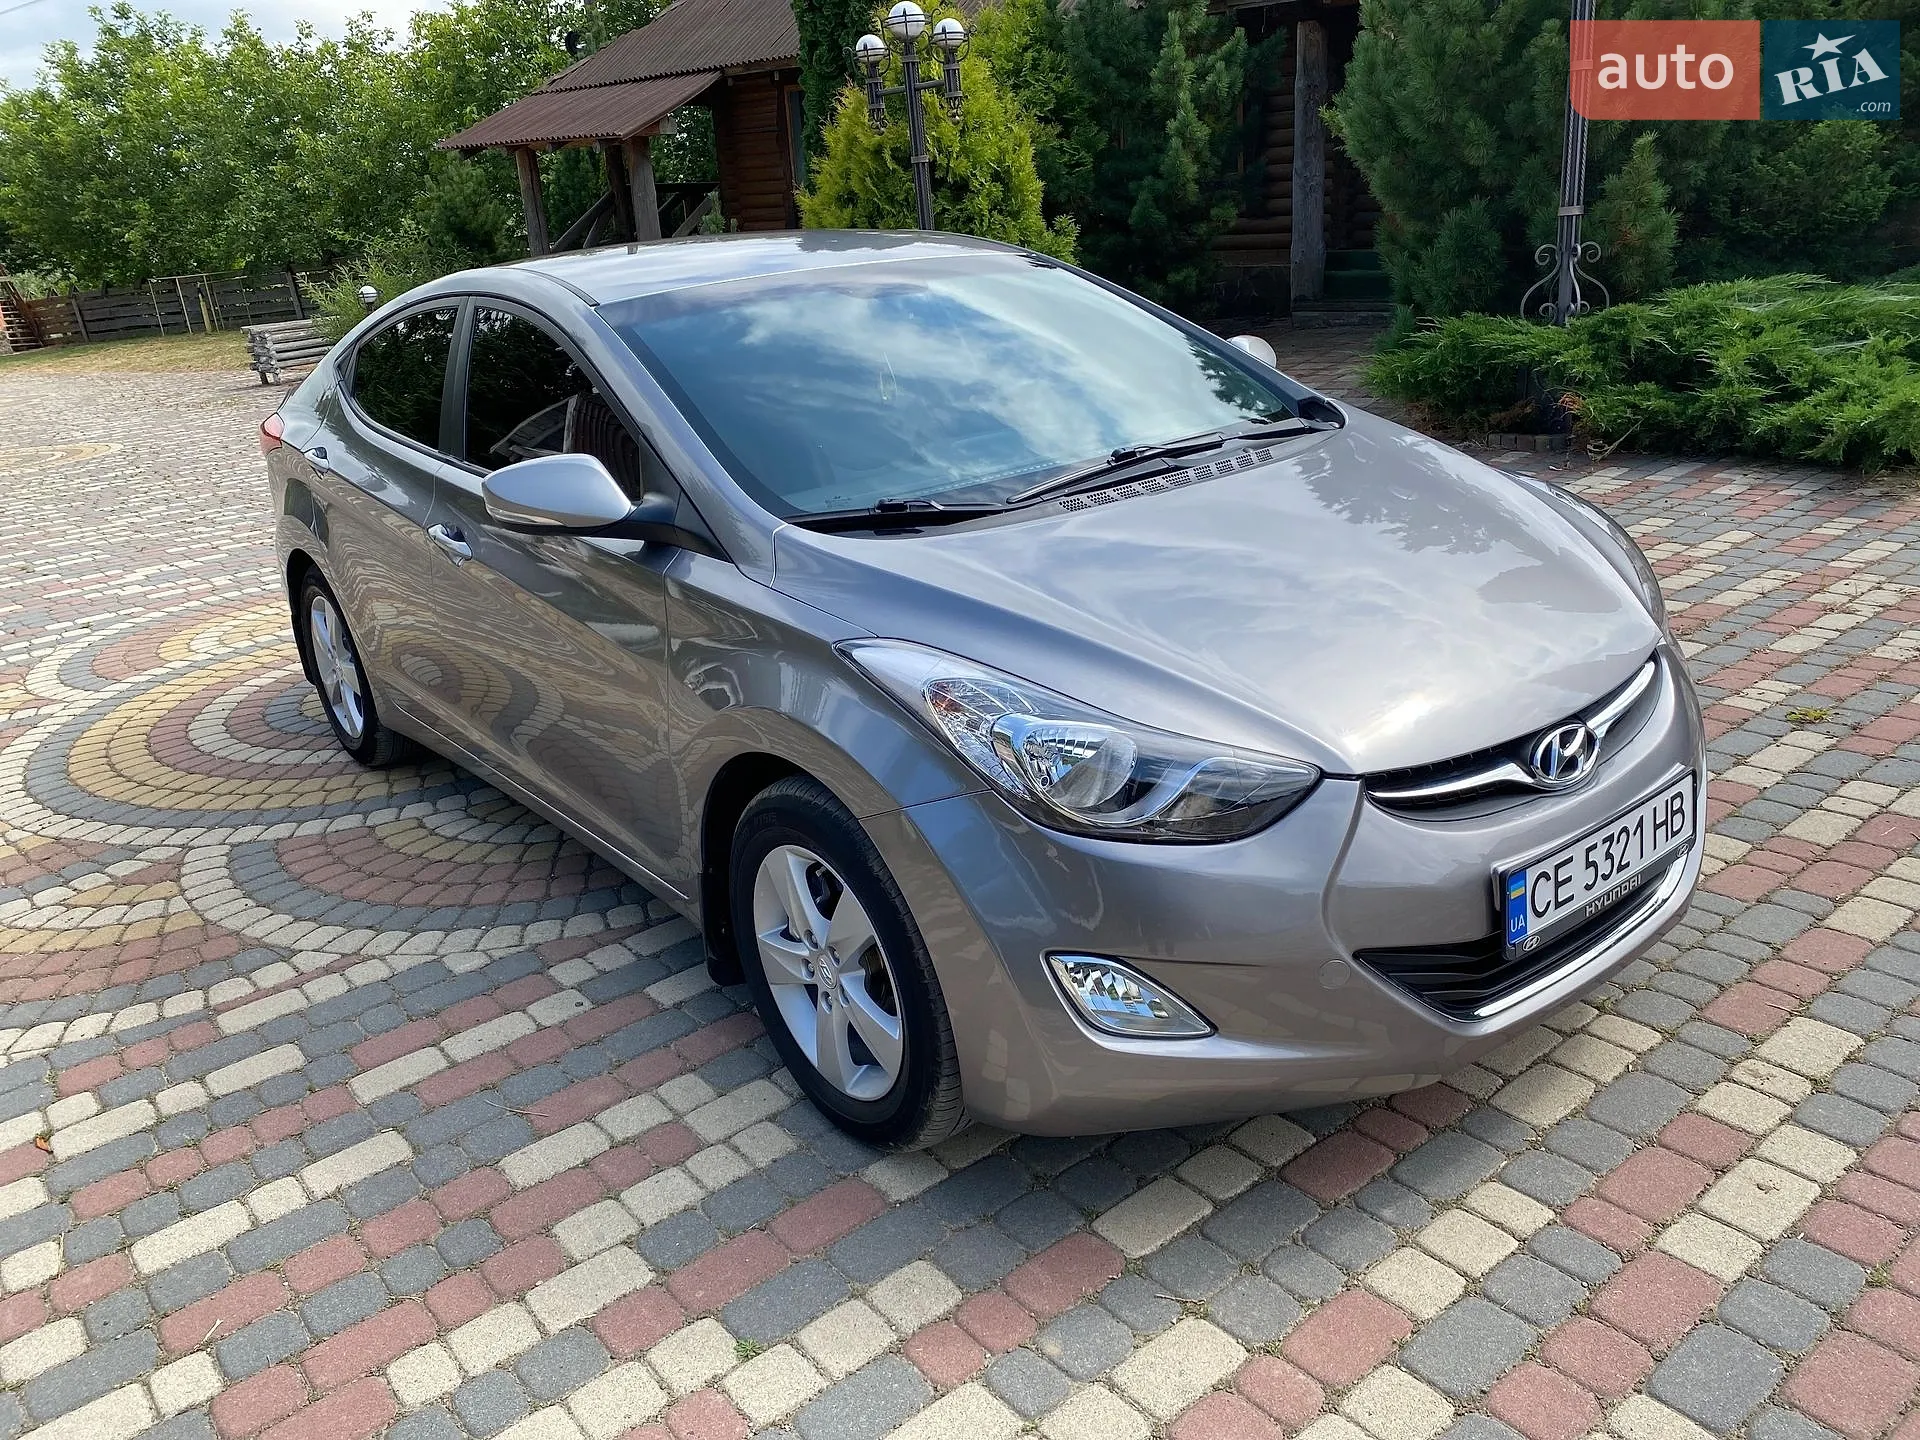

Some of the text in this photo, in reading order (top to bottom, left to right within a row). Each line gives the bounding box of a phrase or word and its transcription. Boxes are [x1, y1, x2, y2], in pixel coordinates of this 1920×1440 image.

[1531, 791, 1685, 918] CE 5321 HB
[1585, 874, 1641, 917] HYUNDAI
[1510, 916, 1526, 932] UA
